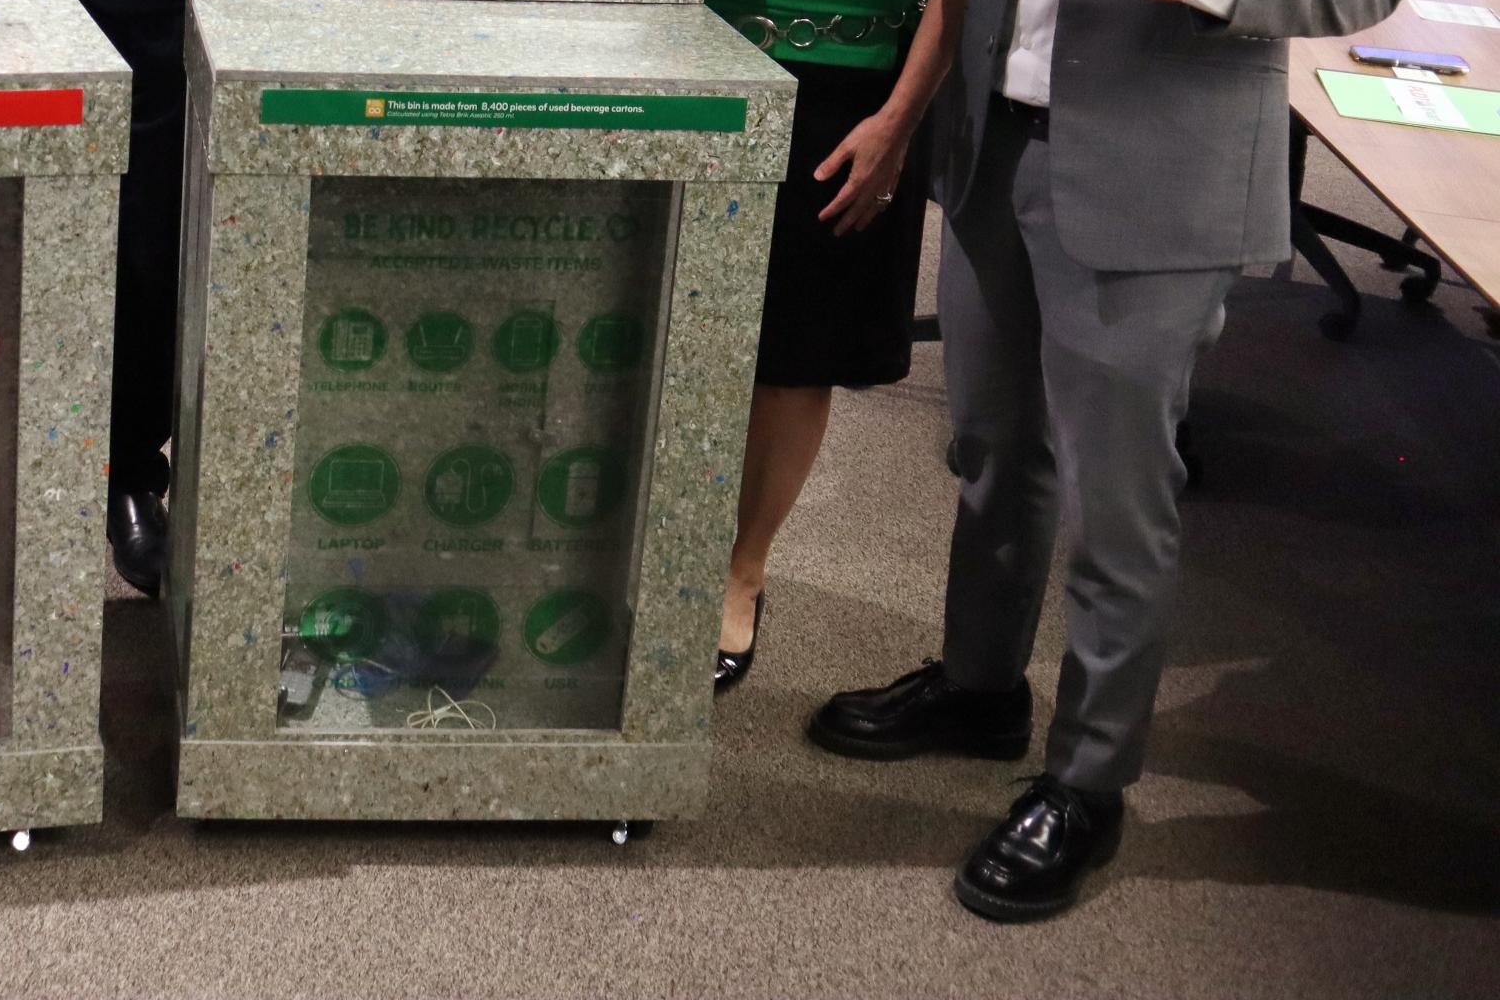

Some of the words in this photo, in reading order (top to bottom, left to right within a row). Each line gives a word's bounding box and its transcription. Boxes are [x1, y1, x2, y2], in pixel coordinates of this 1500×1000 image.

[388, 100, 406, 110] This
[407, 101, 421, 110] bin
[422, 101, 430, 110] is
[431, 101, 456, 110] made
[457, 101, 478, 111] from
[509, 103, 537, 112] pieces
[538, 102, 548, 112] of
[549, 103, 569, 112] used
[571, 103, 610, 114] beverage
[611, 104, 645, 113] cartons.
